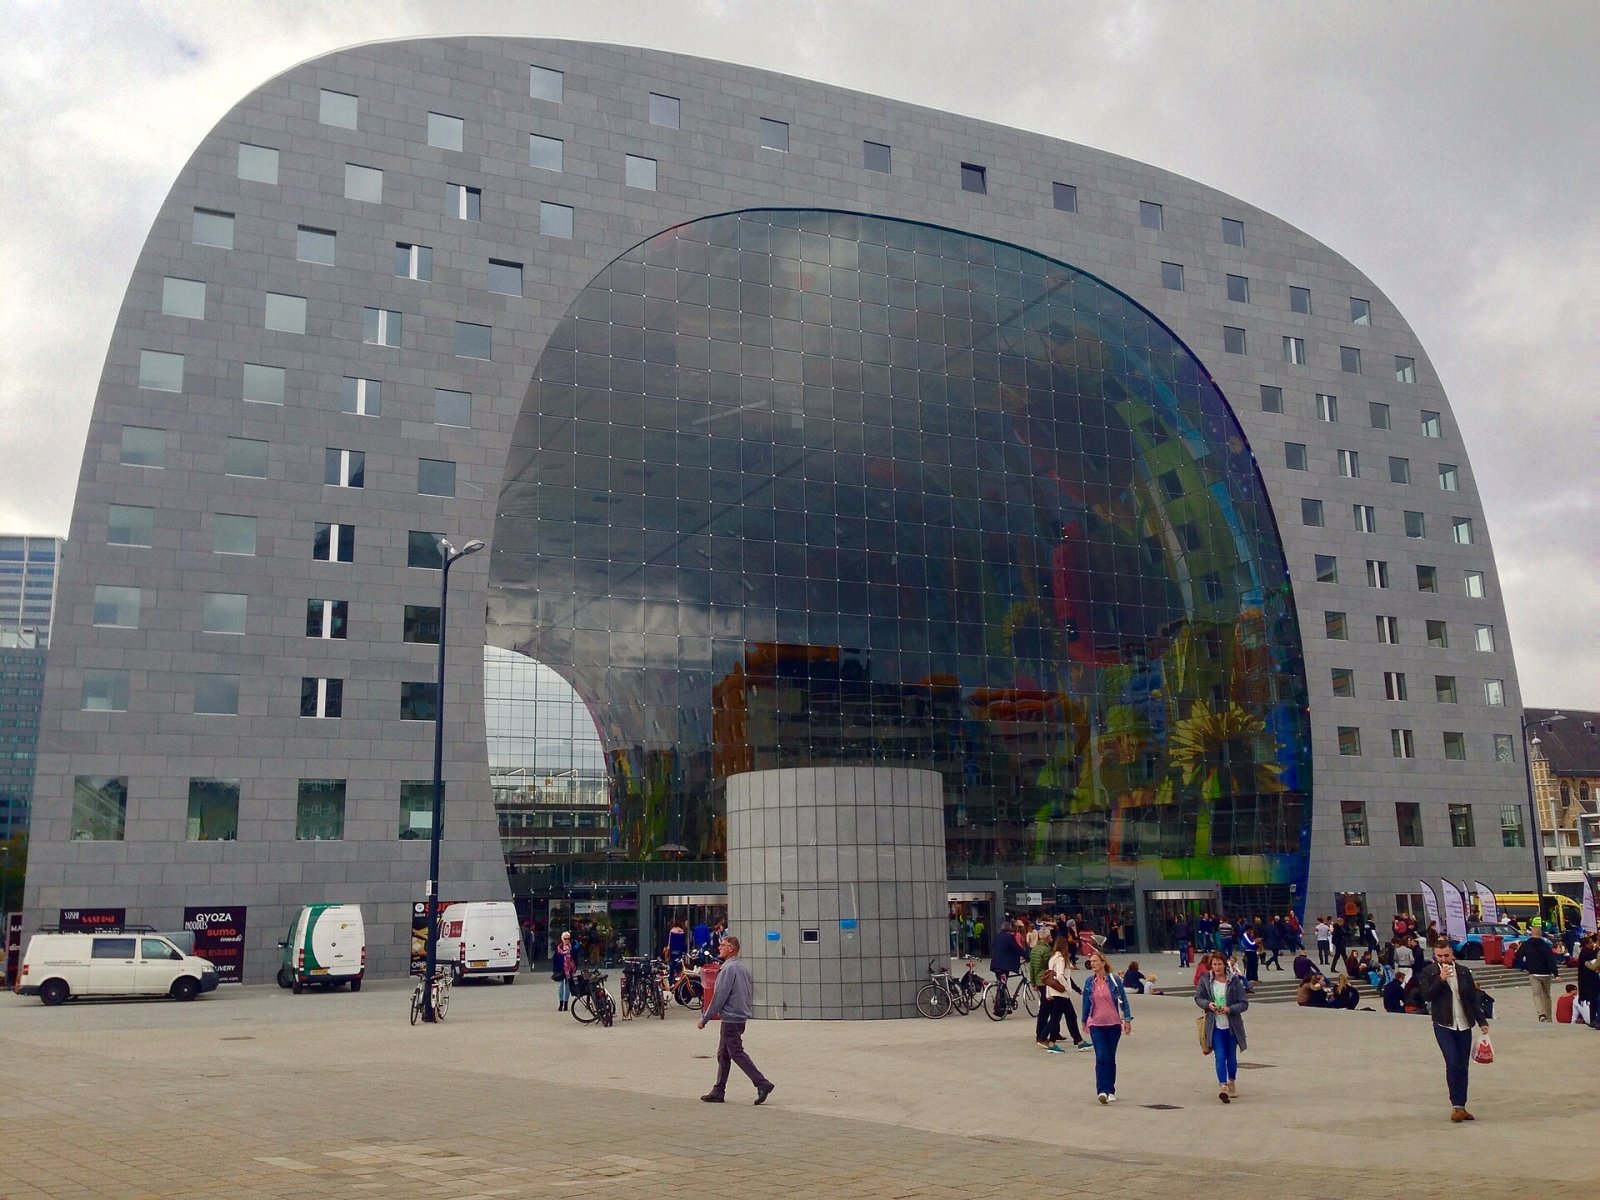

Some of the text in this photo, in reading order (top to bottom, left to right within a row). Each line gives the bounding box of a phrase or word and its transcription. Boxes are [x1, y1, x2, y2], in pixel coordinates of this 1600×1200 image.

[64, 911, 80, 920] SUSHI
[195, 913, 232, 922] GYOZA
[207, 928, 237, 937] sumo
